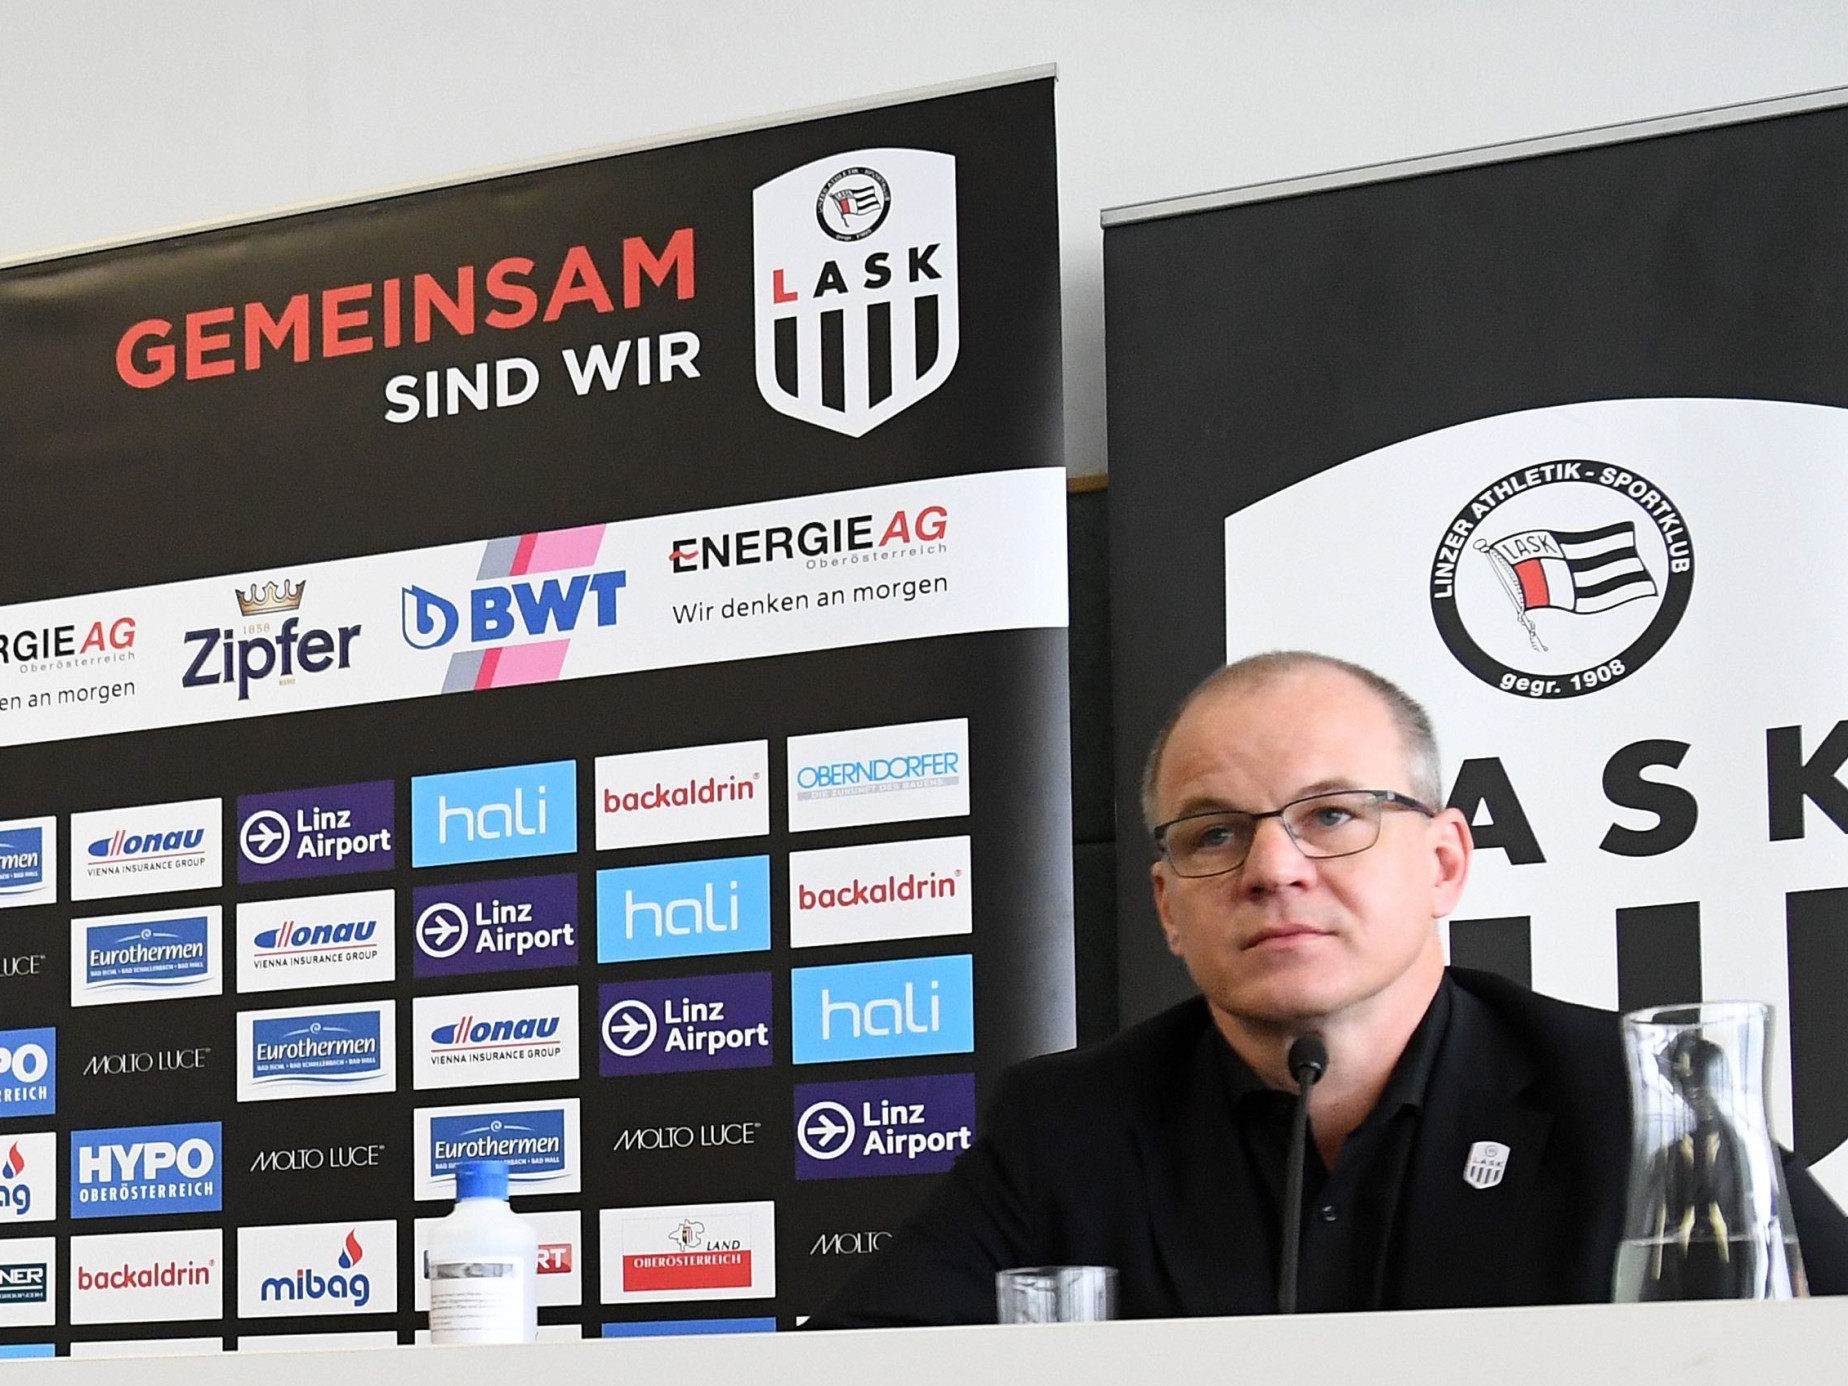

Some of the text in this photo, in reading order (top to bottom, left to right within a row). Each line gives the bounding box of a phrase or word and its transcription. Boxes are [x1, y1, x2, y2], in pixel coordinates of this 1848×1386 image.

[772, 242, 943, 304] LASK
[116, 227, 696, 388] GEMEINSAM
[384, 330, 701, 423] SIND WIR
[669, 505, 948, 574] ENERGIE AG
[1434, 518, 1474, 599] LINZER
[1470, 462, 1582, 519] ATHLETIK
[1599, 466, 1691, 573] SPORTKLUB
[805, 543, 948, 570] Oberösterreich
[1501, 534, 1558, 560] LASK
[471, 570, 627, 642] BWT
[672, 576, 948, 624] Wir denken an morgen
[79, 617, 137, 654] AG
[19, 652, 136, 674] Oberösterreich
[182, 617, 362, 701] Zipfer
[1499, 658, 1626, 696] gegr. 1908
[28, 691, 51, 708] an
[58, 681, 136, 704] morgen
[797, 752, 959, 789] OBERNDORFER
[603, 775, 754, 813] backaldrin
[1445, 719, 1848, 867] ASK
[297, 807, 351, 832] Linz
[439, 785, 546, 844] hali
[296, 829, 391, 861] Airport
[87, 857, 206, 878] VIENNA INSURANCE GROUP
[799, 872, 956, 910] backaldrin
[476, 900, 532, 926] Linz
[624, 880, 739, 940] hali
[90, 941, 203, 967] Eurothermen
[475, 923, 575, 955] Airport
[253, 950, 378, 970] VIENNA INSURANCE GROUP
[664, 997, 725, 1024] Linz
[821, 980, 940, 1040] hali
[257, 1037, 376, 1061] Eurothermen
[664, 1023, 769, 1055] Airport
[83, 1048, 205, 1076] MOLTO LUCE
[431, 1047, 561, 1065] VIENNA INSURANCE GROUP
[863, 1100, 925, 1127] Linz
[435, 1136, 559, 1159] Eurothermen
[613, 1123, 755, 1151] MOLTO LUCE
[862, 1126, 972, 1159] Airport
[79, 1138, 214, 1184] HYPO
[250, 1145, 379, 1173] MOLTO LUCE
[79, 1181, 213, 1203] OBERÖSTERREICH
[707, 1240, 741, 1251] LAND
[78, 1261, 210, 1291] backaldrin
[261, 1269, 370, 1307] mibag
